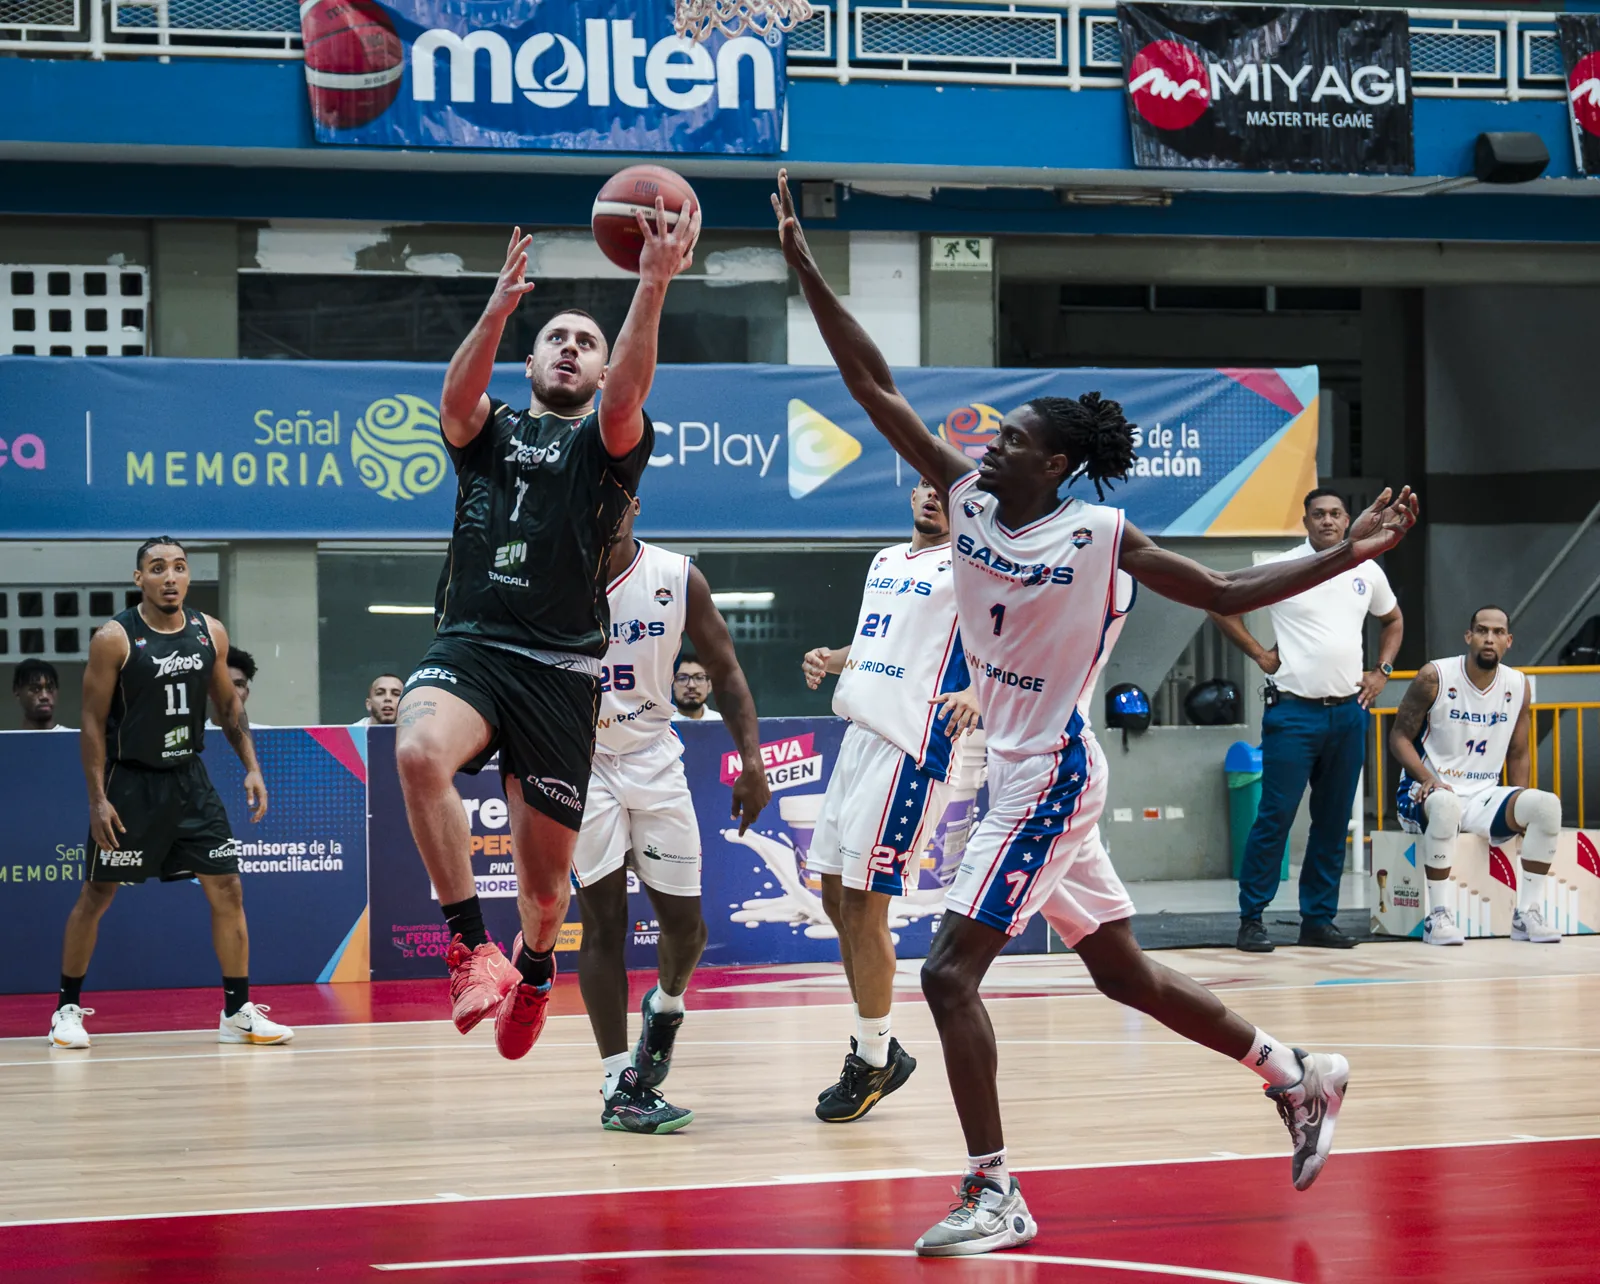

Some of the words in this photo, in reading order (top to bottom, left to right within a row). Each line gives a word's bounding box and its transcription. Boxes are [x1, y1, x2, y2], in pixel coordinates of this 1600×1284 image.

[1208, 63, 1407, 105] MIYAGI
[1246, 111, 1301, 126] MASTER
[1303, 112, 1330, 127] THE
[1332, 113, 1374, 128] GAME
[253, 409, 340, 445] Señal
[1149, 423, 1173, 448] de
[1181, 423, 1200, 448] la
[127, 451, 343, 486] MEMORIA
[488, 570, 529, 587] EMCALI
[860, 613, 892, 638] 21
[990, 603, 1006, 637] 1
[601, 664, 636, 693] 25
[164, 682, 190, 716] 11
[161, 749, 193, 758] EMCALI
[727, 740, 804, 775] NEVA
[1466, 739, 1488, 756] 14
[526, 775, 583, 812] Electrolite
[100, 857, 143, 867] TECH
[235, 840, 307, 856] Emisoras
[309, 840, 325, 855] de
[330, 840, 342, 854] la
[868, 844, 914, 876] 21
[1004, 869, 1030, 907] 1
